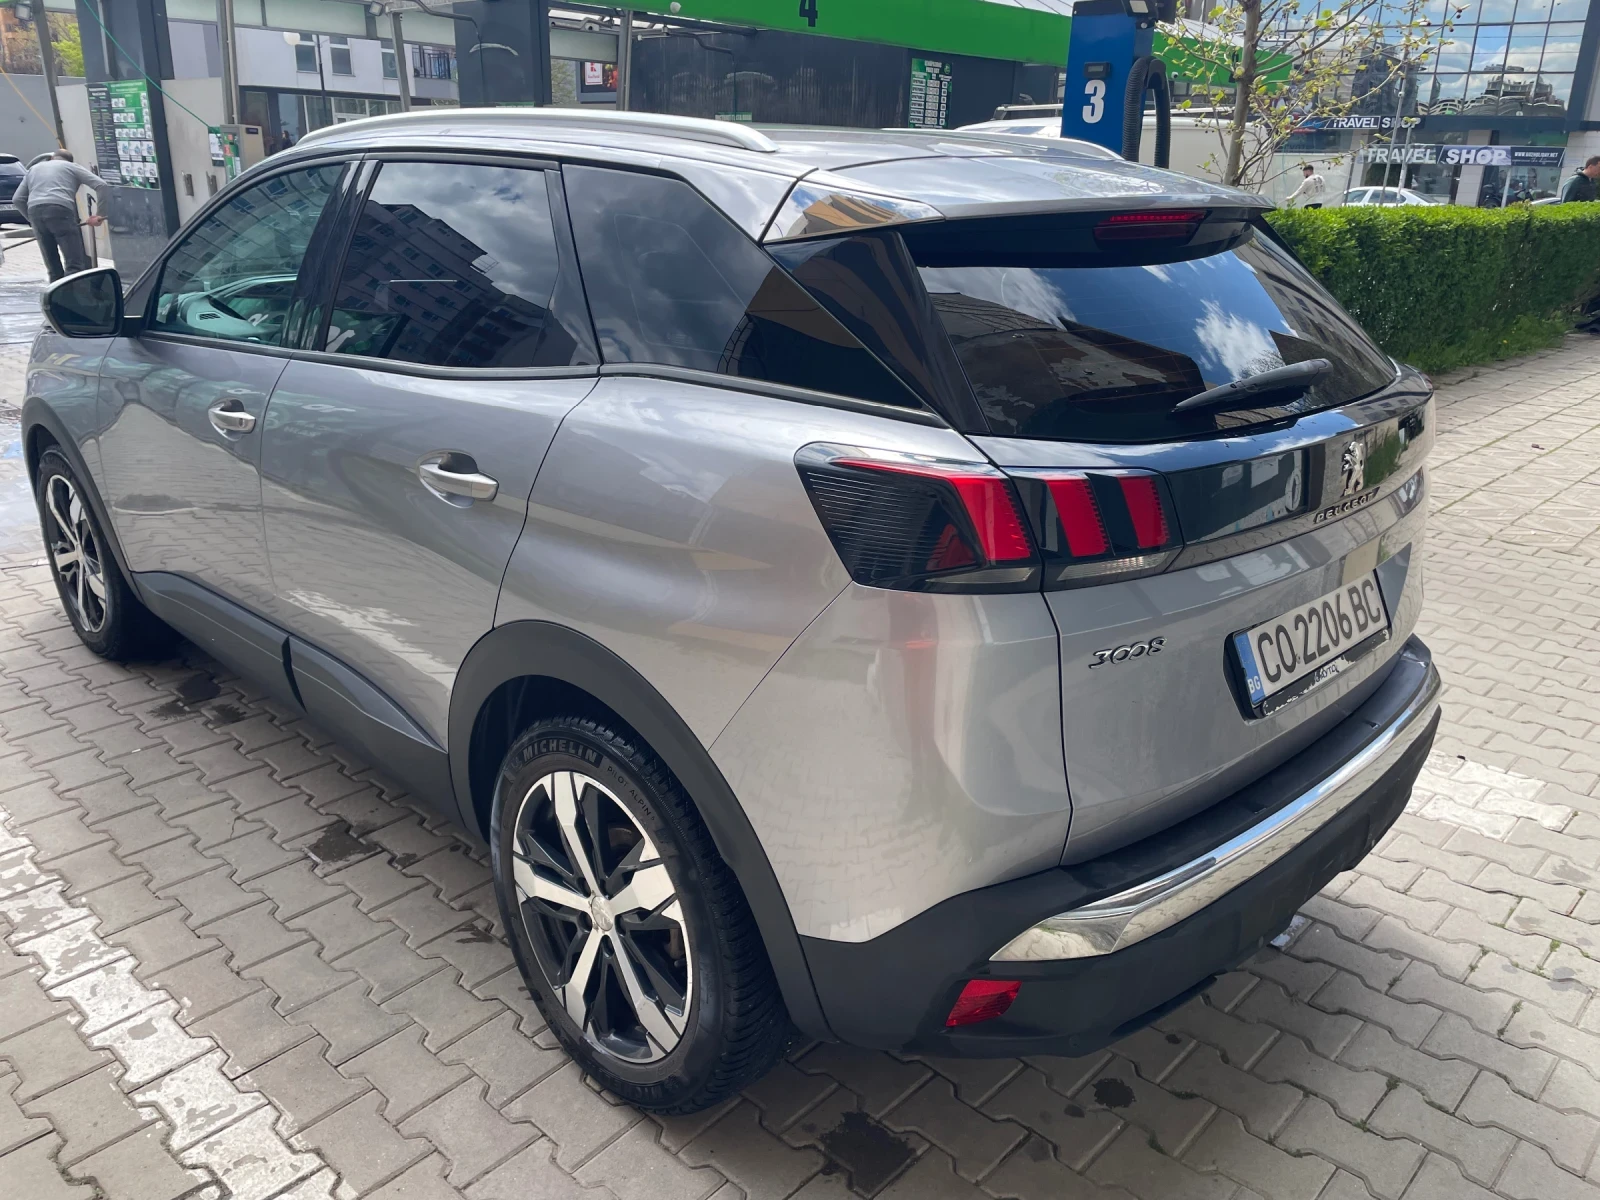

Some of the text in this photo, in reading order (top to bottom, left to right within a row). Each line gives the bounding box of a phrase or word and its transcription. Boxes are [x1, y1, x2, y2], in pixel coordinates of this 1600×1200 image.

[799, 0, 818, 27] 4
[1082, 80, 1106, 124] 3
[1333, 117, 1378, 128] TRAVEL
[1367, 148, 1436, 163] TRAVEL
[1446, 149, 1507, 165] SHOP
[1315, 489, 1378, 523] PEUGEOT
[1088, 636, 1167, 669] 3008
[1247, 676, 1261, 694] BG
[523, 739, 598, 763] MICHELIN
[607, 765, 628, 787] PILOT
[629, 789, 651, 816] ALPIN
